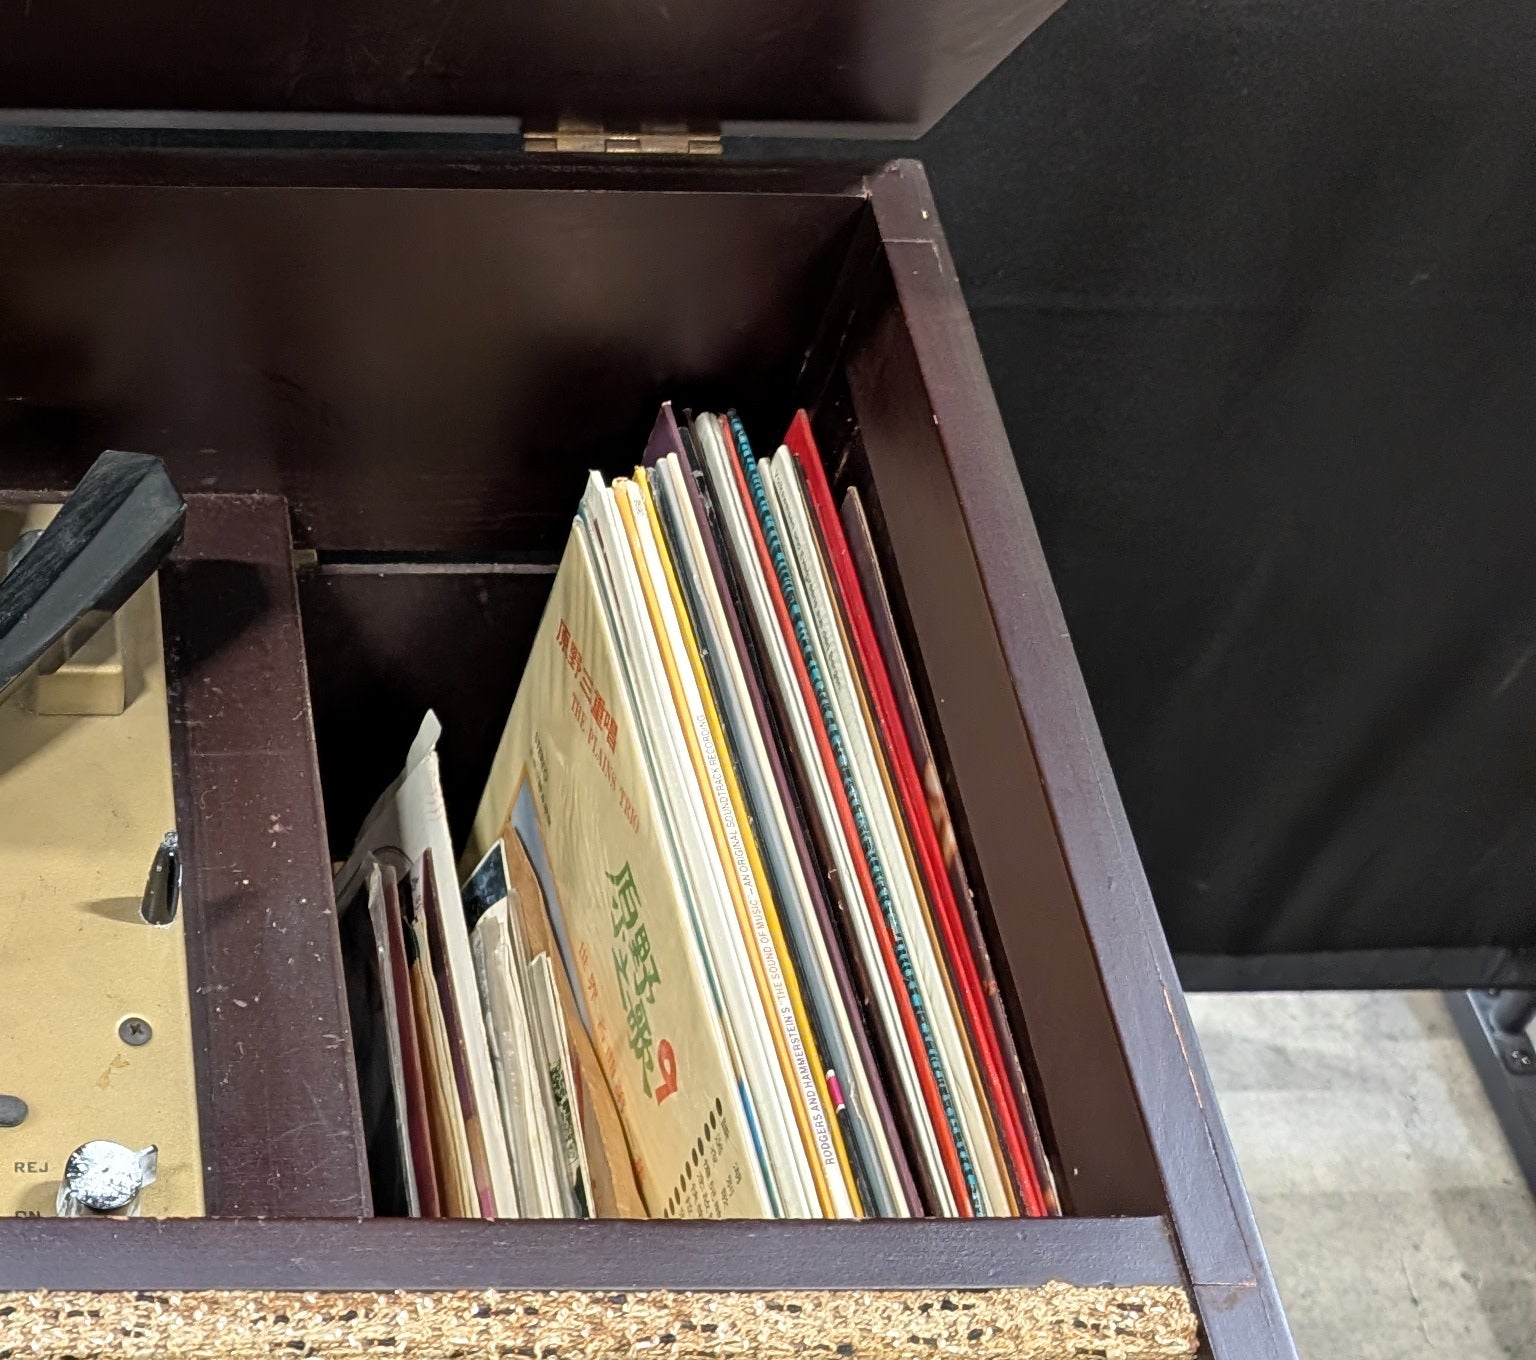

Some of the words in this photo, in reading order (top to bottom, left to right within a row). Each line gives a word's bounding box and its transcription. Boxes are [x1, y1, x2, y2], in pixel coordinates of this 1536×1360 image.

[556, 618, 618, 754] 原野三重唱
[570, 692, 586, 732] THE
[587, 727, 618, 792] PLAINS
[618, 787, 640, 834] TRIO
[696, 713, 718, 766] RECORDING
[712, 767, 736, 828] SOUNDTRACK
[729, 831, 749, 873] ORIGINAL
[758, 931, 771, 944] OF
[763, 946, 781, 980] SOUND
[780, 1007, 813, 1089] HAMMERSTEIN'S
[806, 1090, 823, 1112] AND
[813, 1115, 835, 1165] RODGERS
[14, 1161, 49, 1173] REJ
